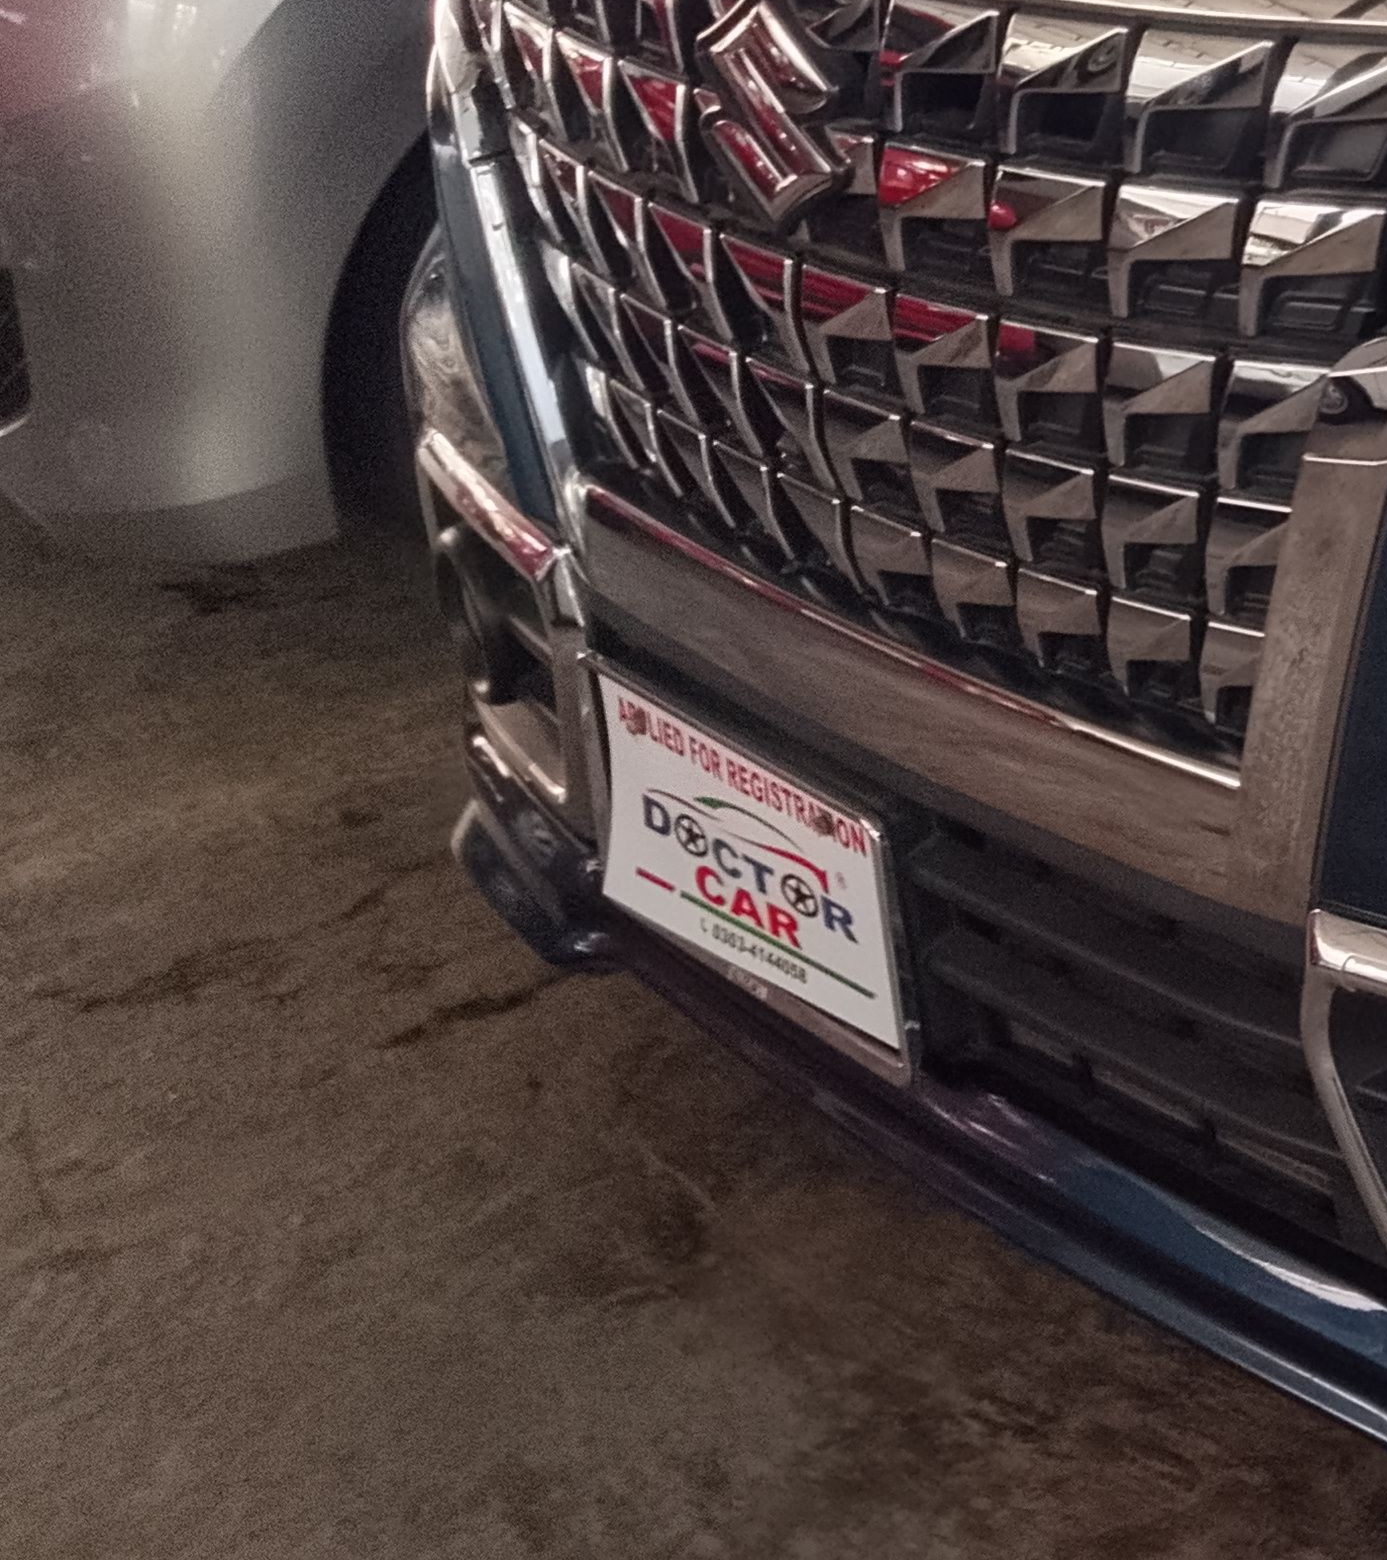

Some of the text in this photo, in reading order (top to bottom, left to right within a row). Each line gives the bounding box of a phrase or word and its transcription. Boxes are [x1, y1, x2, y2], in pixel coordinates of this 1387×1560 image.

[617, 695, 867, 858] APLIED FOR REGISTRAION
[642, 793, 859, 944] DOCTOR
[695, 864, 802, 949] CAR
